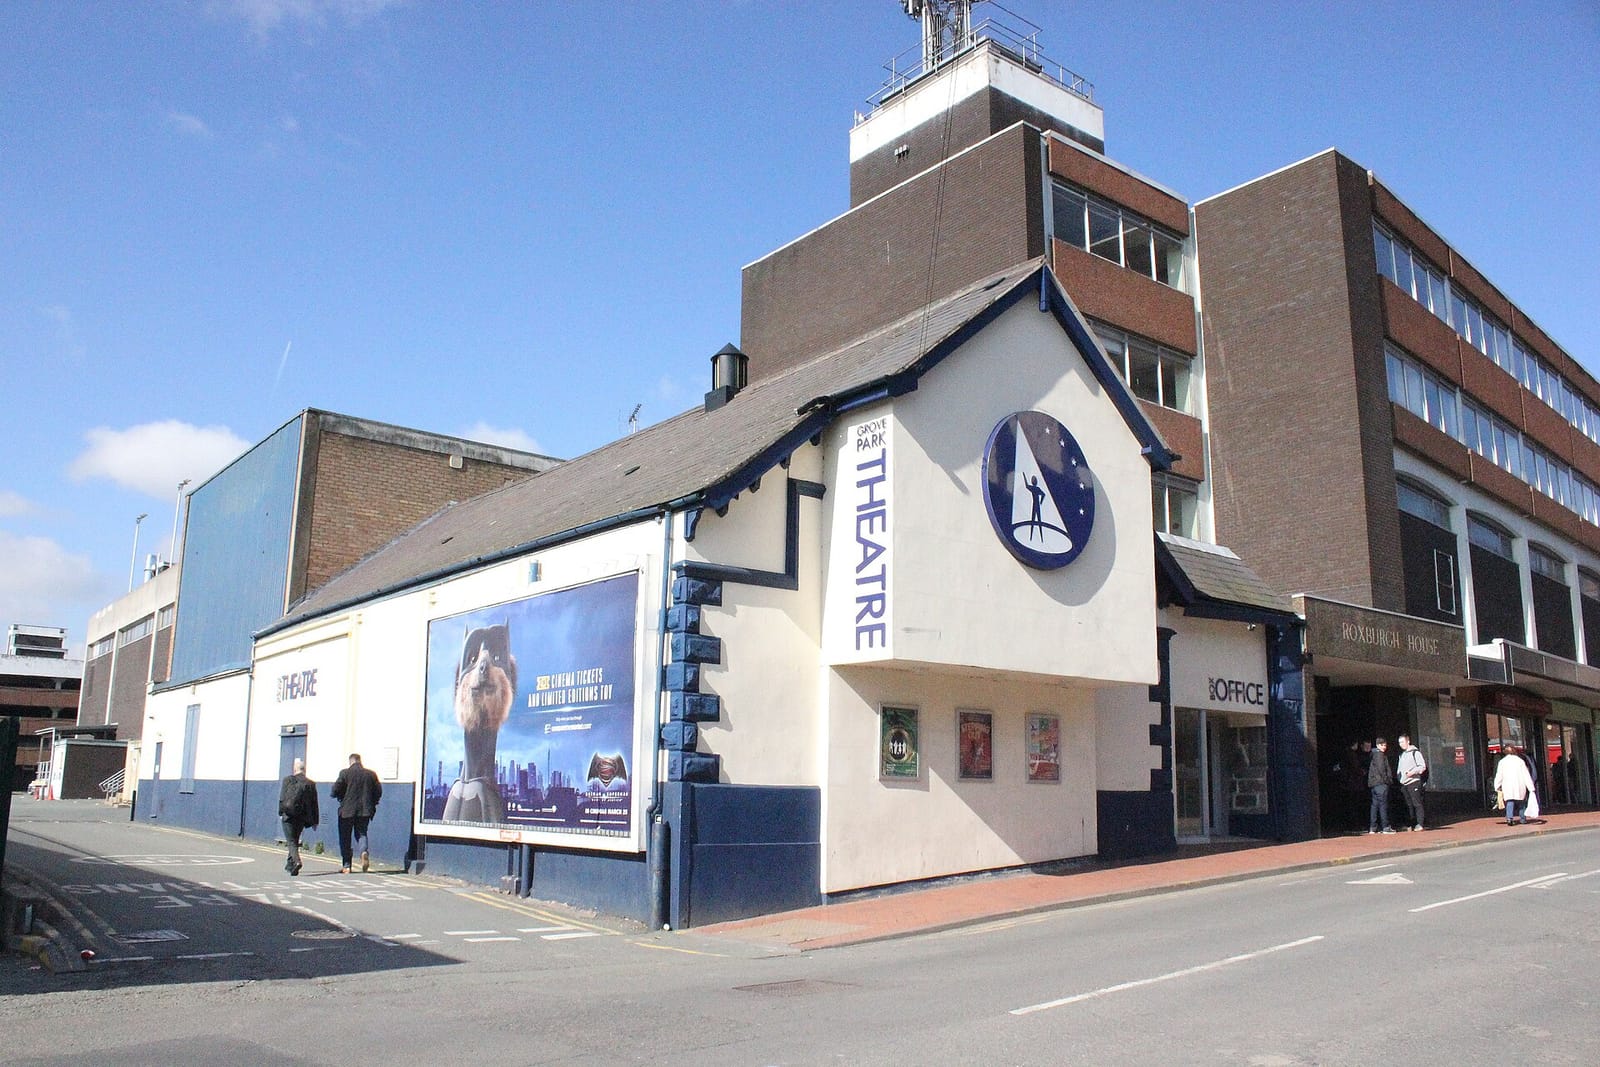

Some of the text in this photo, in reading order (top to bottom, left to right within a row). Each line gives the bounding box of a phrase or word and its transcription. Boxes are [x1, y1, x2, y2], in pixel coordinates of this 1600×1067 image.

[857, 418, 887, 437] GROVE
[857, 431, 887, 452] PARK
[856, 448, 887, 651] THEATRE
[1342, 622, 1440, 655] ROXBURGH HOUSE
[281, 668, 318, 701] THEATRE
[551, 671, 575, 689] CINEMA
[576, 667, 603, 686] TICKETS
[1208, 677, 1216, 701] BOX
[528, 692, 540, 708] AND
[541, 689, 566, 707] LIMITED
[1215, 678, 1264, 705] OFFICE
